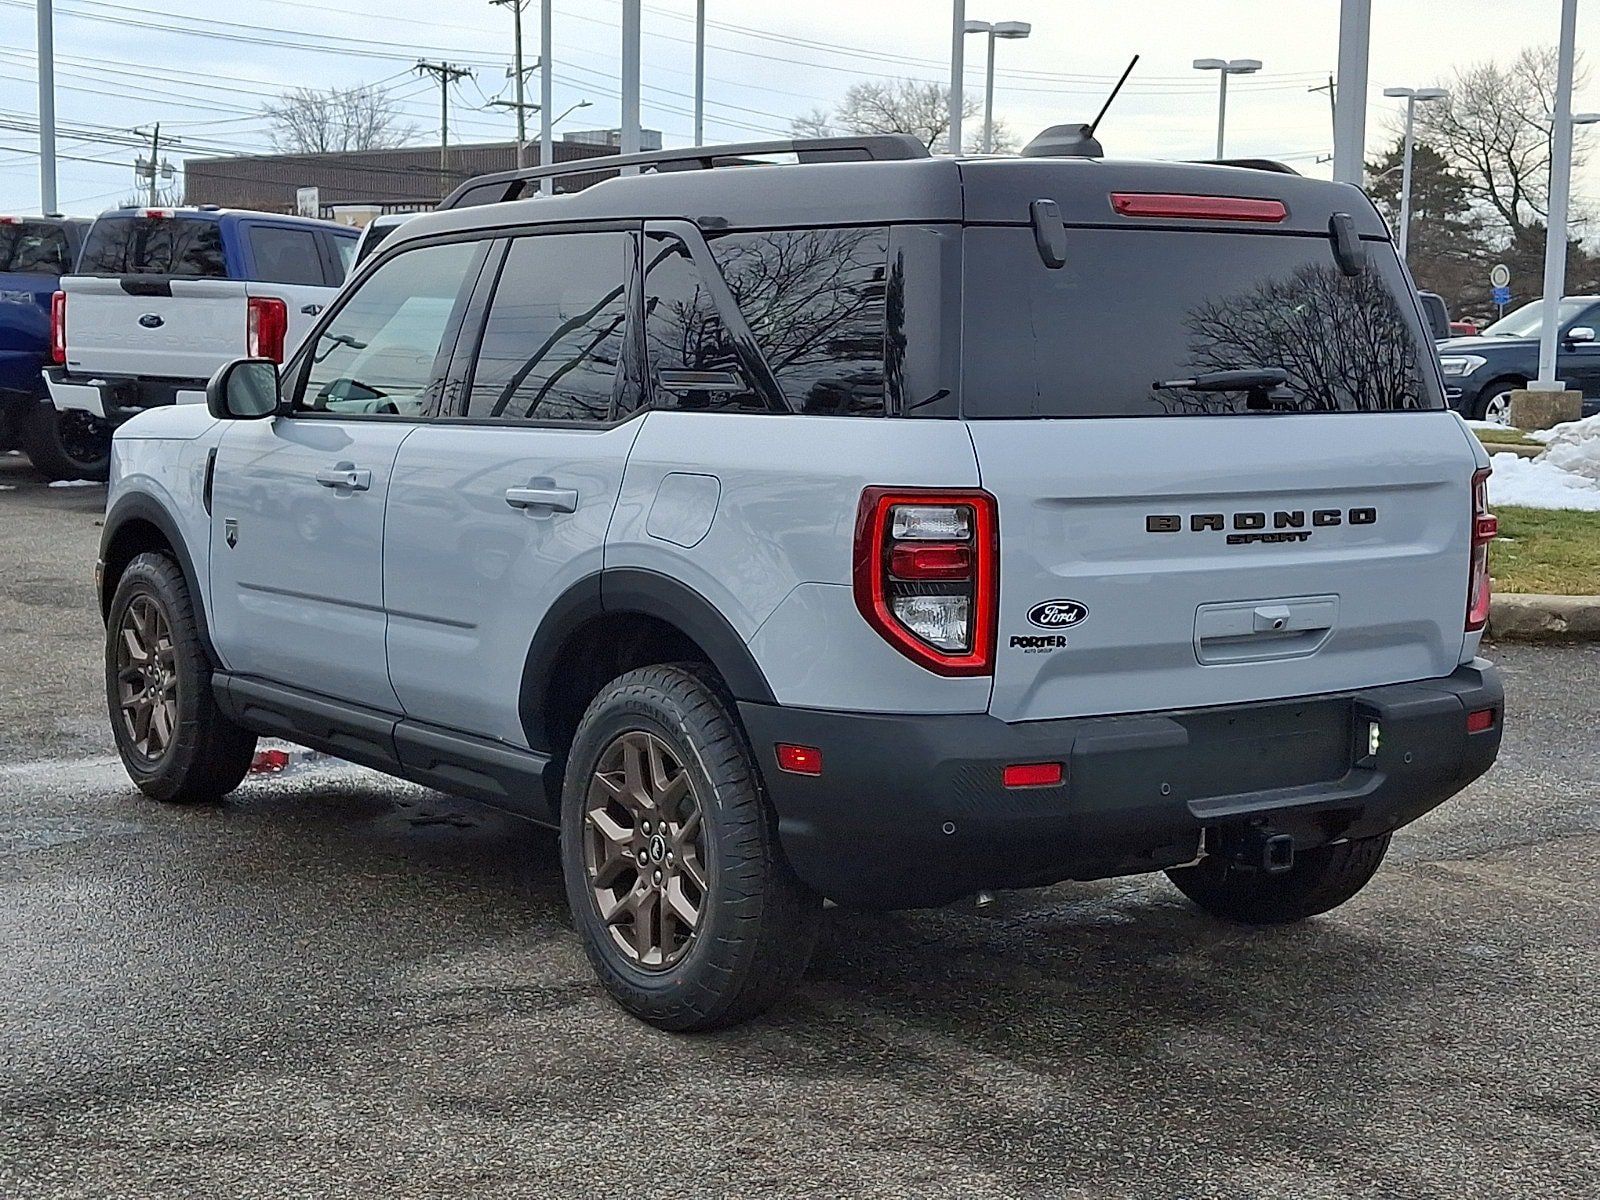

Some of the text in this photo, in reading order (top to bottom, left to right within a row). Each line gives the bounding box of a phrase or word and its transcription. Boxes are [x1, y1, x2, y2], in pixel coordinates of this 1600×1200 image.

[1146, 507, 1377, 533] BRONCO
[1226, 531, 1312, 545] SPORT
[1040, 604, 1078, 623] Ford
[1010, 635, 1067, 648] PORTER
